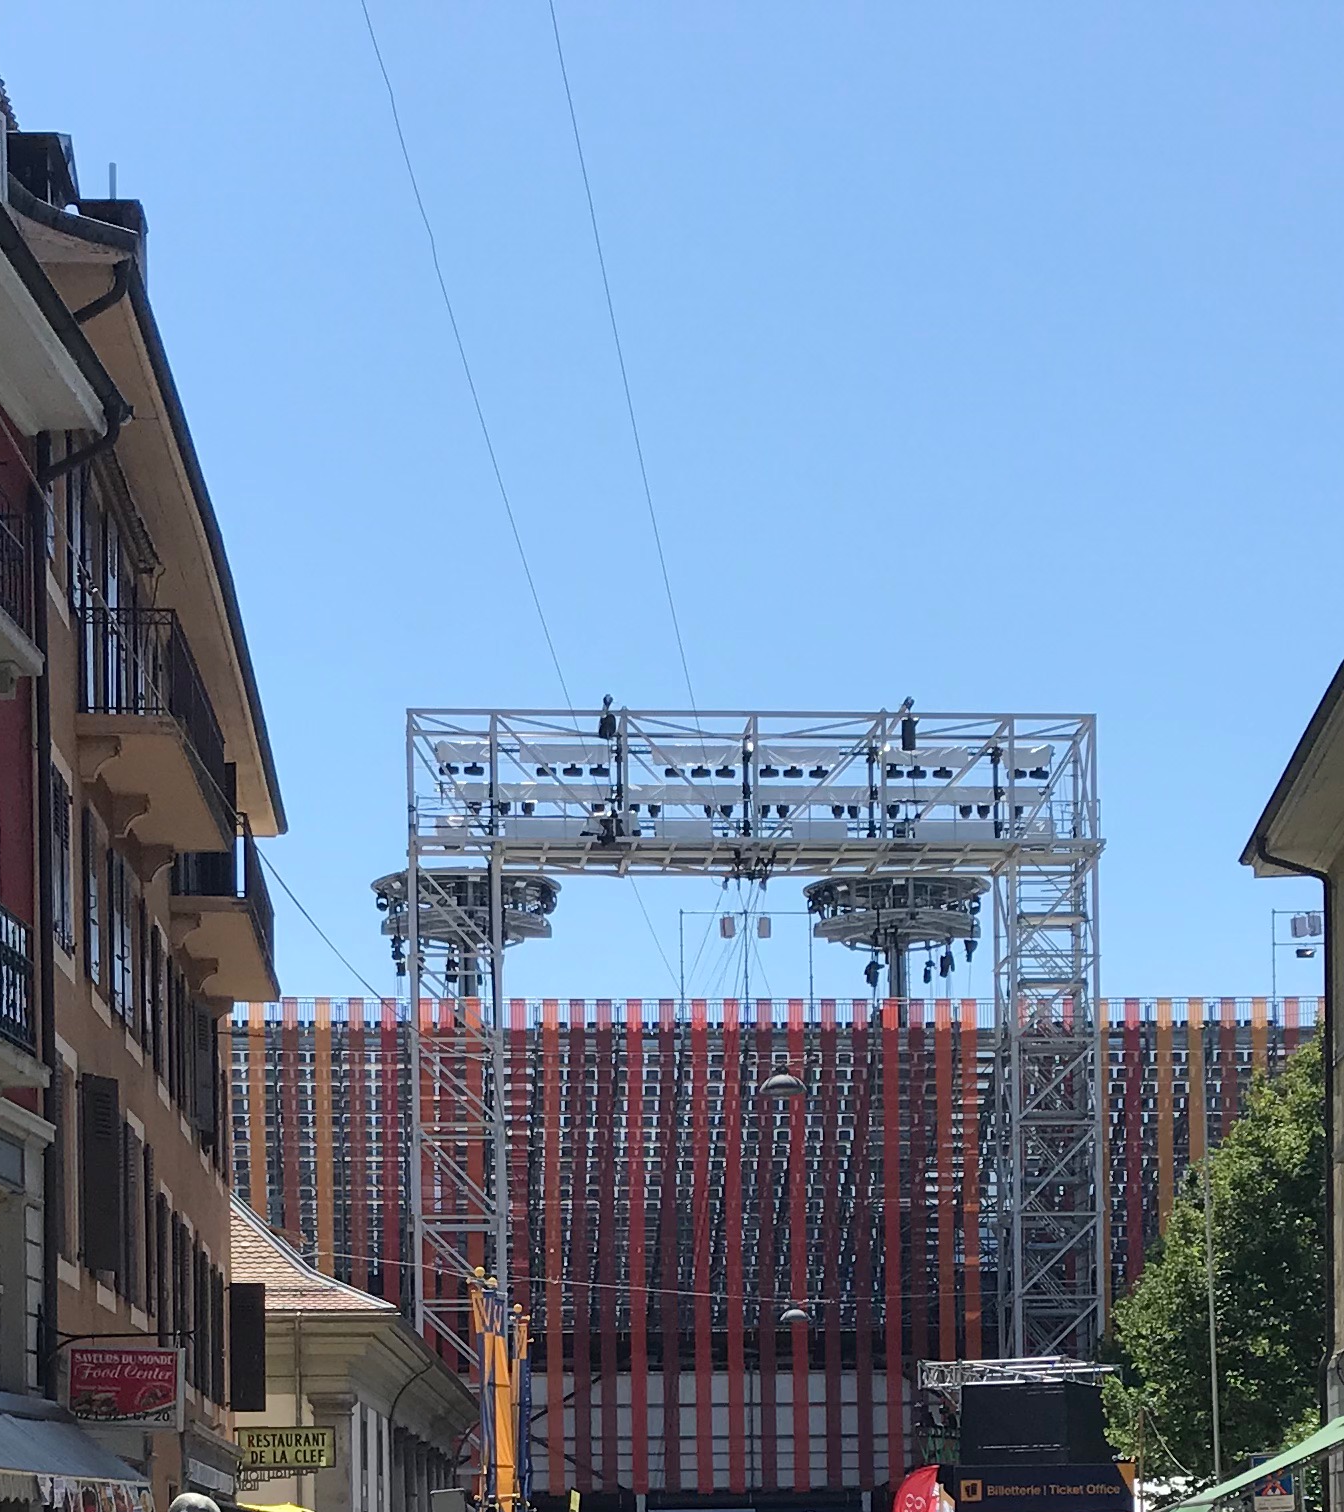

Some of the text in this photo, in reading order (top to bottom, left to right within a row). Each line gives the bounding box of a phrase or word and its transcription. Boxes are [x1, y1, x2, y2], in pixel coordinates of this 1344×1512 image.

[75, 1353, 173, 1366] SAVEURS DU MONDE
[75, 1362, 173, 1380] Food Center
[153, 1412, 170, 1421] 20
[247, 1433, 327, 1448] RESTAURANT
[250, 1449, 326, 1464] DE LA CLEF
[987, 1484, 1120, 1496] Billetterie Ticket Office
